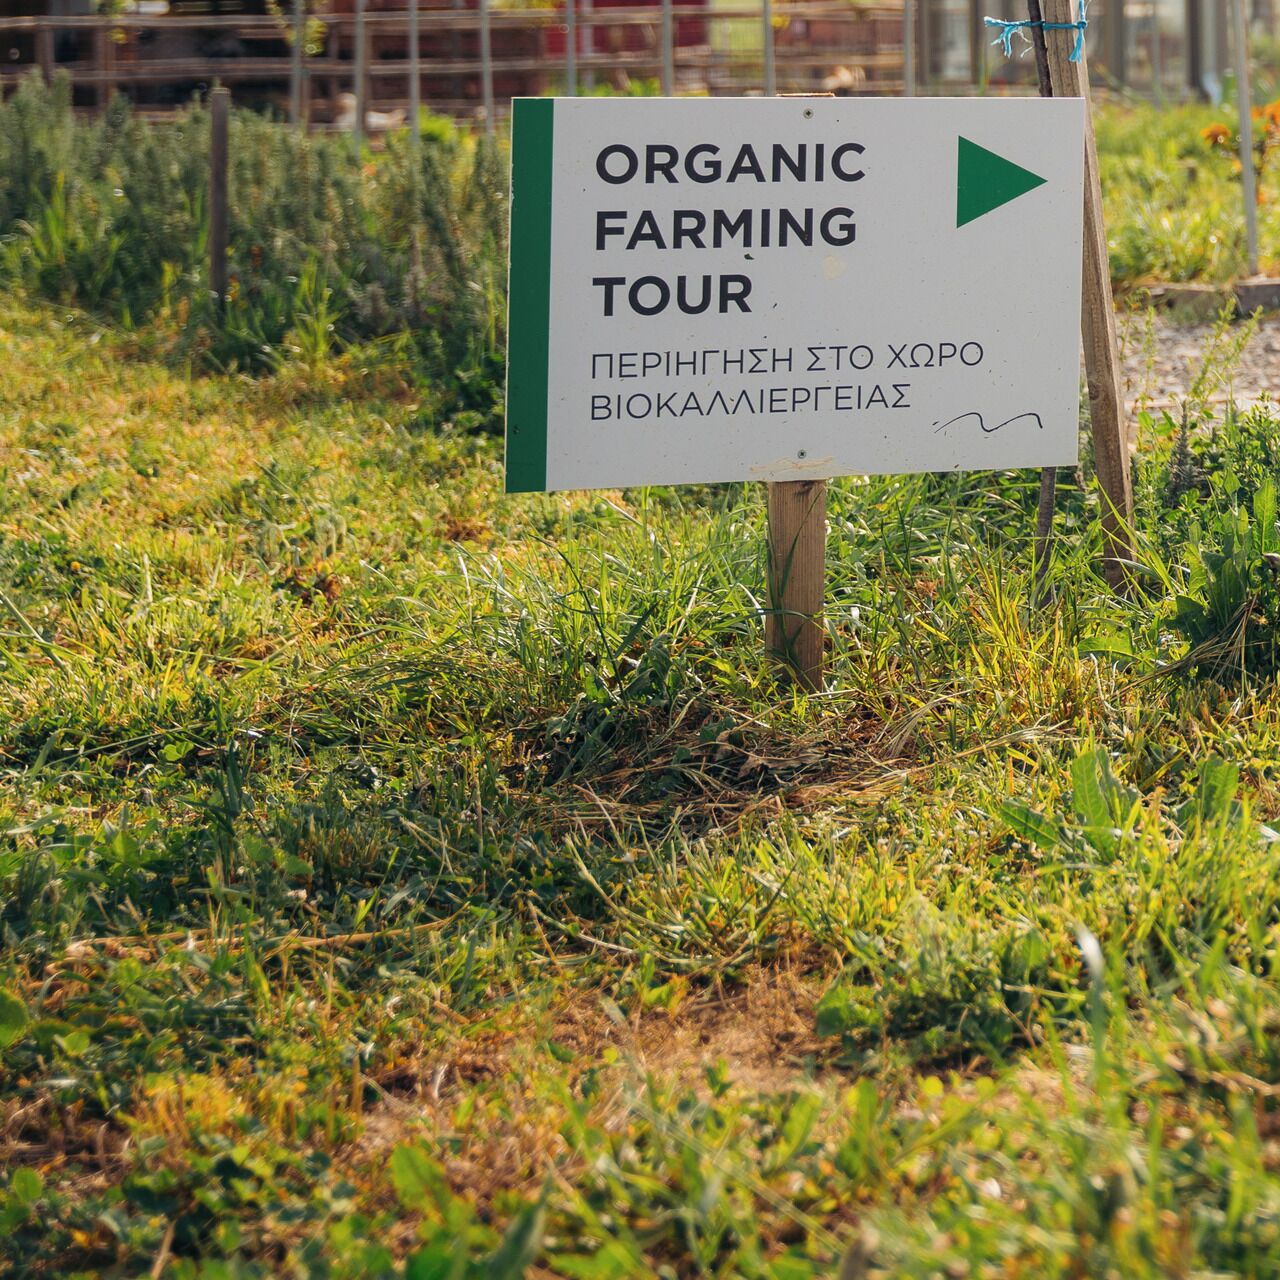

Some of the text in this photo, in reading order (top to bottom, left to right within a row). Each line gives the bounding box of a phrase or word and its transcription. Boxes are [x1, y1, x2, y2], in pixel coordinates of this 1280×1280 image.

[595, 142, 867, 185] ORGANIC
[595, 206, 857, 251] FARMING
[592, 274, 754, 317] TOUR
[590, 340, 985, 380] ΠΕΡΙΗΓΗΣΗ ΣΤΟ ΧΩΡΟ
[590, 382, 912, 421] ΒΙΟΚΑΛΛΙΕΡΓΕΙΑΣ
